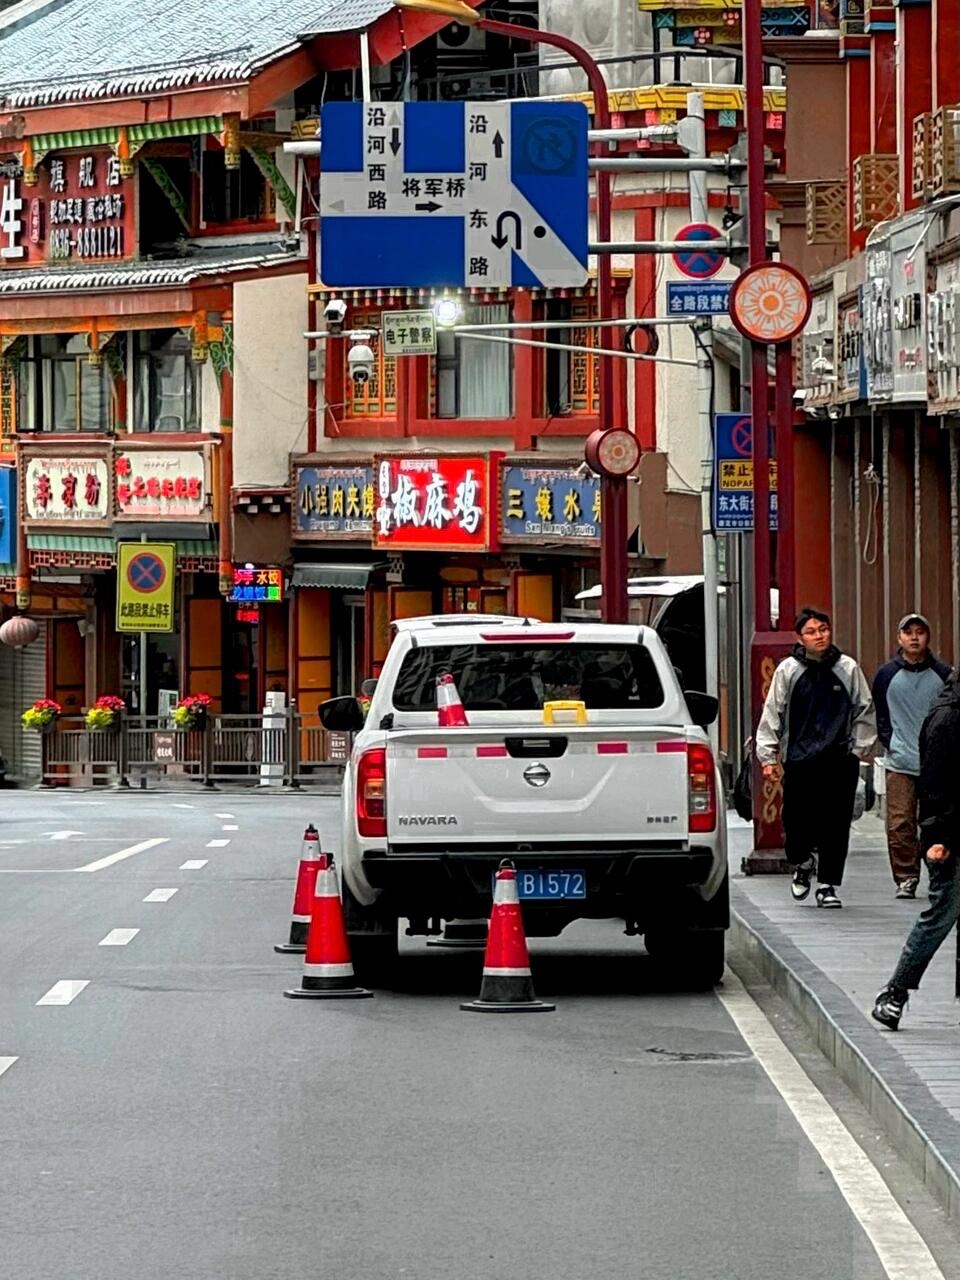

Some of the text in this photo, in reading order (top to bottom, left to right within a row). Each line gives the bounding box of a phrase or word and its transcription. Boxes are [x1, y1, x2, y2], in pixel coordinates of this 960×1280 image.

[367, 107, 387, 210] 沿河西路
[50, 156, 121, 192] 旗舰店
[401, 177, 466, 199] 将军桥
[469, 114, 489, 276] 沿河东路
[50, 226, 122, 258] 0836-8881121
[386, 327, 432, 345] 电子警察
[723, 464, 778, 477] 禁止车
[723, 479, 778, 488] NOPAG
[300, 484, 374, 518] 小强肉夹馍
[391, 469, 483, 534] 椒麻鸡
[718, 494, 778, 512] 东大街段
[256, 570, 278, 586] 水饺
[121, 602, 170, 619] 此路段禁止停车
[398, 815, 458, 826] NAVARA
[524, 873, 584, 894] B1572
